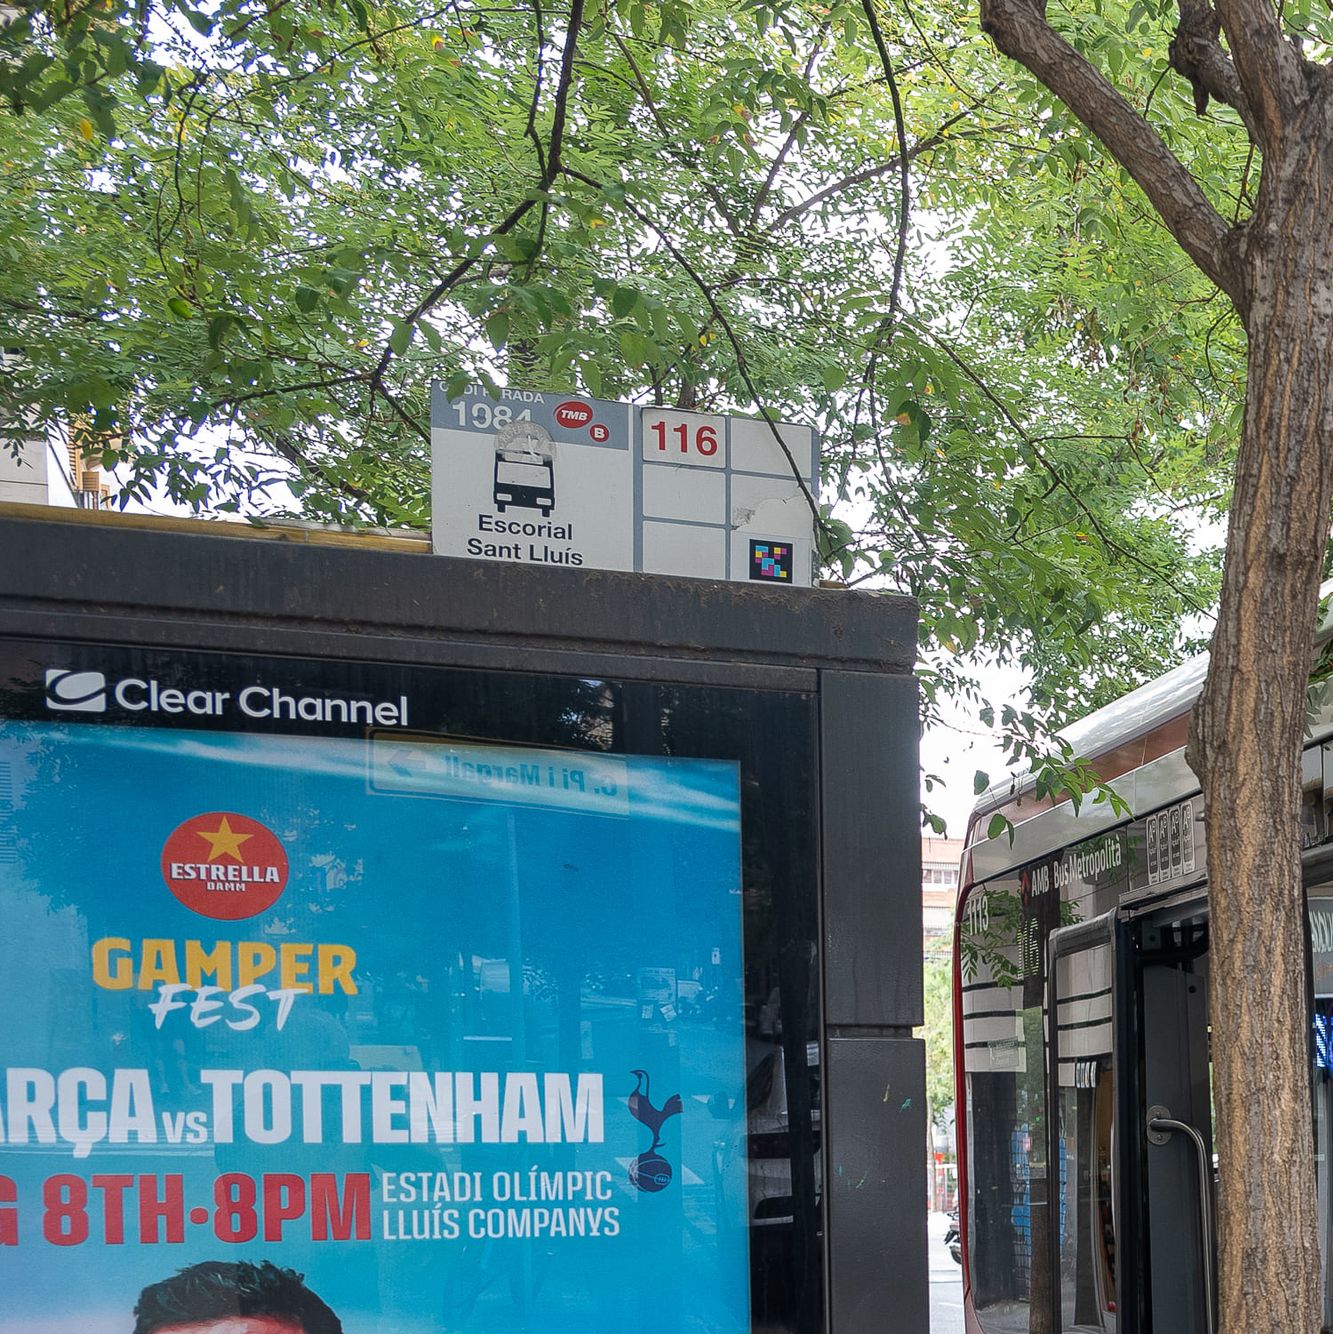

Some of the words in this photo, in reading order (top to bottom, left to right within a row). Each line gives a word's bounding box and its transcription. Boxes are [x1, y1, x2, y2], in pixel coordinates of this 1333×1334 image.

[560, 409, 588, 421] TMB
[594, 428, 605, 439] B
[649, 419, 719, 457] 116
[478, 514, 573, 541] Escorial
[467, 538, 521, 559] Sant
[529, 544, 583, 567] Lluís
[115, 678, 230, 716] Clear
[239, 686, 408, 726] Channel
[169, 863, 281, 885] ESTRELLA
[206, 882, 246, 893] DAMM
[1031, 865, 1050, 897] AMB
[92, 938, 358, 996] GAMPER
[148, 984, 313, 1032] FEST
[0, 1067, 157, 1158] RÇA
[201, 1069, 604, 1144] TOTTENHAM
[382, 1172, 484, 1203] ESTADI
[494, 1166, 613, 1201] OLÍMPIC
[383, 1205, 461, 1240] LLUÍS
[469, 1207, 620, 1239] COMPANYS
